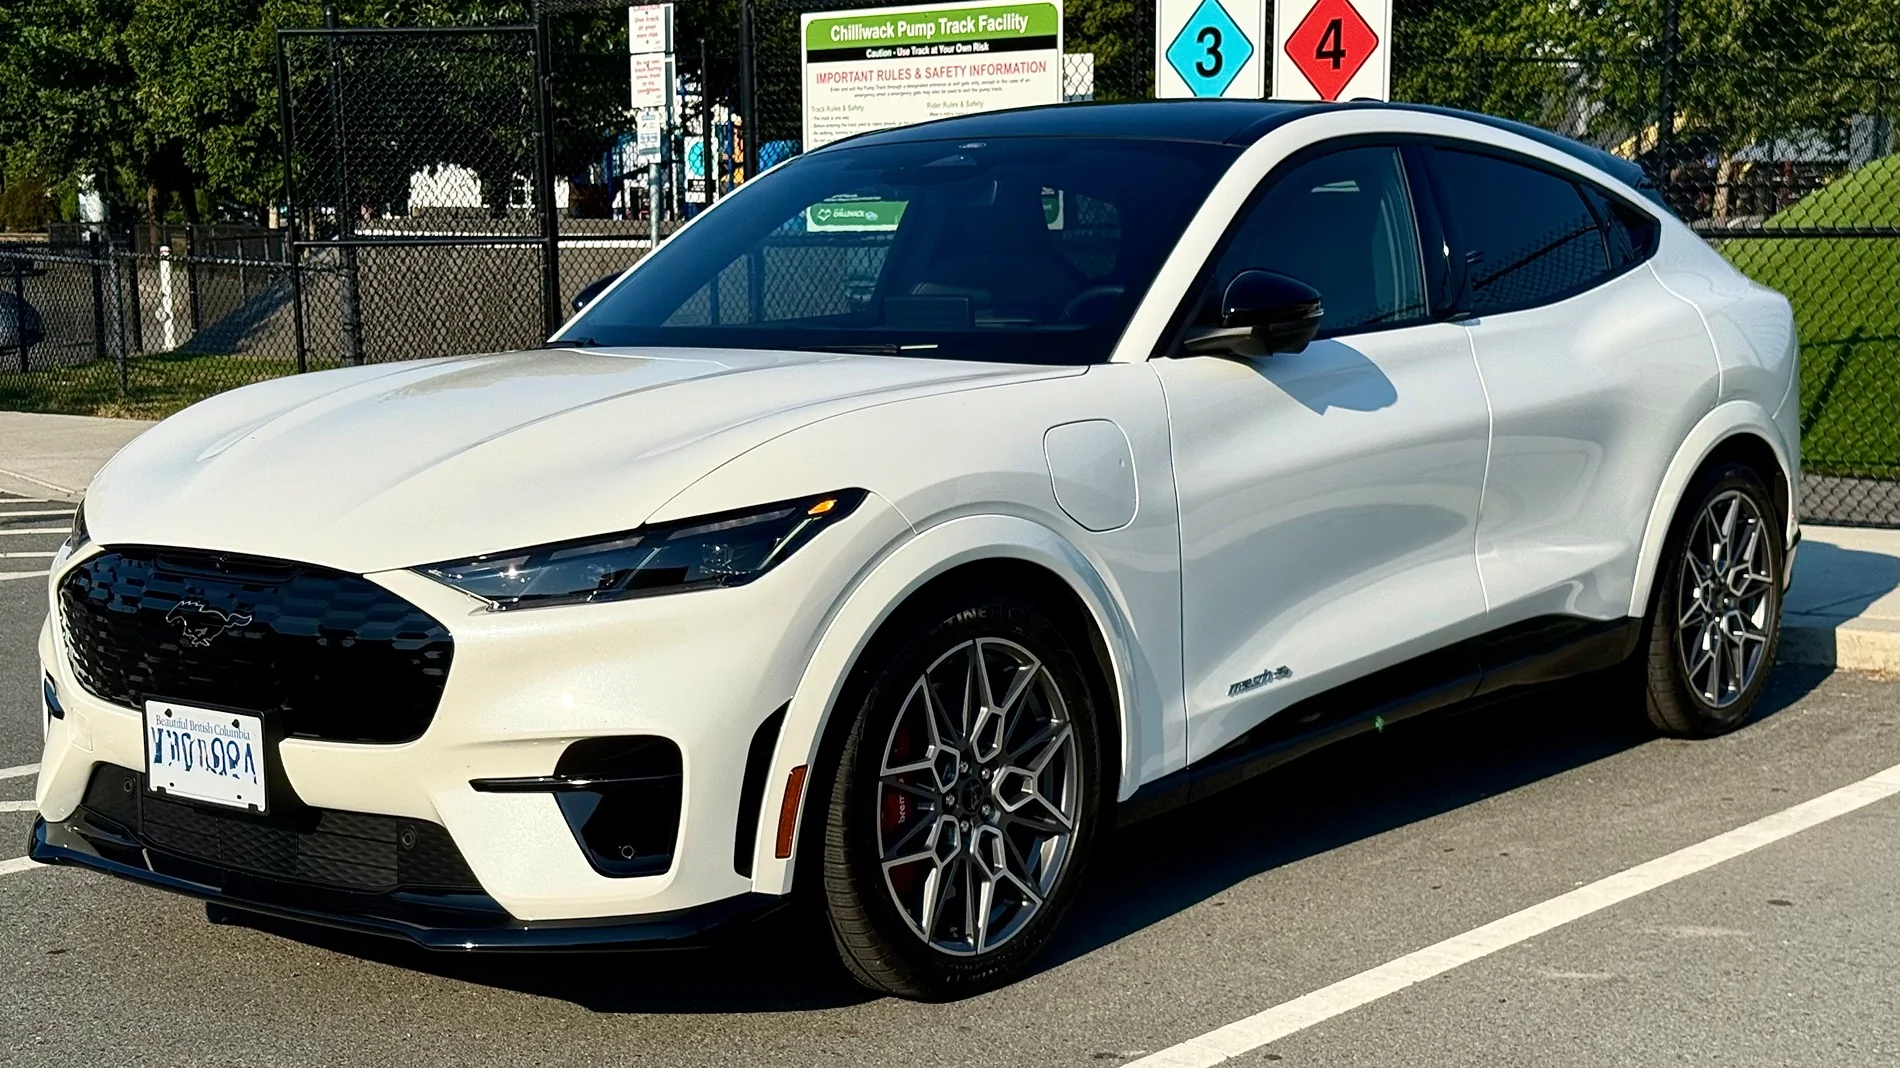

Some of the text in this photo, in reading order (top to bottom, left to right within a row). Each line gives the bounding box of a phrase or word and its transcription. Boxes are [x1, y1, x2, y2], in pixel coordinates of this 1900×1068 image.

[830, 13, 1029, 42] Chilliwack Pump Track Facility
[866, 48, 892, 58] Caution
[896, 47, 910, 57] Use
[911, 46, 930, 56] Track
[930, 45, 938, 55] at
[939, 44, 955, 54] Your
[955, 43, 972, 53] Own
[972, 42, 990, 52] Risk
[1195, 27, 1223, 78] 3
[1315, 18, 1346, 70] 4
[816, 61, 1047, 84] IMPORTANT RULES & SAFETY INFORMATION
[848, 104, 864, 112] Safety
[966, 100, 984, 108] Safety
[155, 715, 251, 740] Beautiful British Columbia
